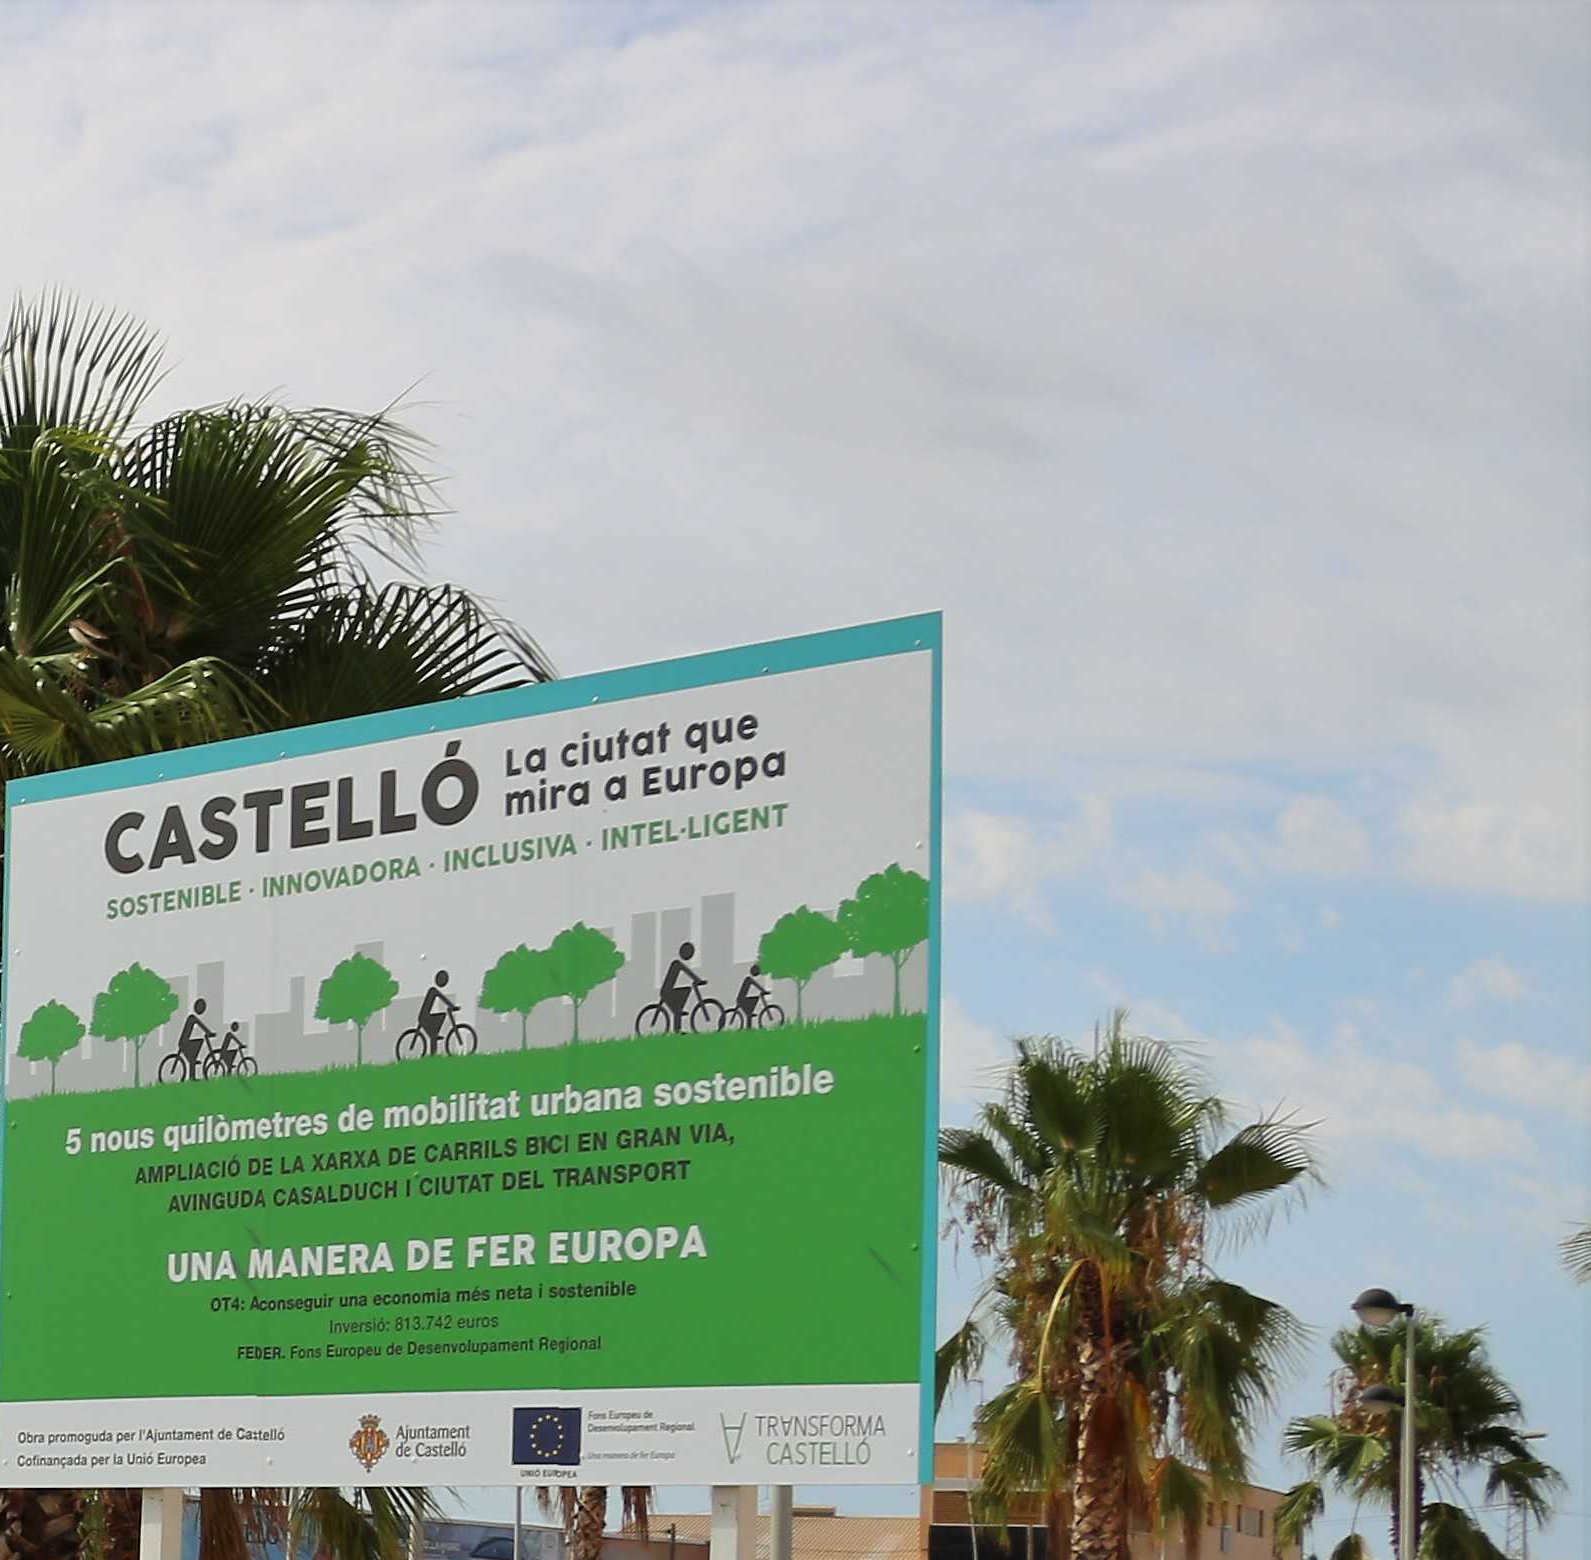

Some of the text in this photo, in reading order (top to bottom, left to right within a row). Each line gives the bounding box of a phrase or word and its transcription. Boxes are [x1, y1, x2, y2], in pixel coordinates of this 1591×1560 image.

[505, 713, 759, 778] La ciutat que
[505, 749, 786, 817] mira a Europa
[104, 739, 480, 874] CASTELLÓ
[106, 880, 242, 920] SOSTENIBLE
[262, 855, 421, 898] INNOVADORA
[443, 832, 578, 873] INCLUSIVA
[65, 1063, 836, 1155] 5 nous quilòmetres de mobilitat urbana sostenible
[135, 1122, 735, 1184] AMPLIACIÓ DE LA XARXA DE CARRILS BICI EN GRAN VIA,
[167, 1160, 691, 1213] AVINGUDA CASALDUCH I CIUTAT DEL TRANSPORT
[167, 1224, 708, 1283] UNA MANERA DE FER EUROPA
[210, 1280, 637, 1312] OT4: Aconseguir una economia més neta i sostenible
[329, 1315, 499, 1334] Inversió: 813.742 euros
[237, 1335, 601, 1360] FEDER. Fons Europeu de Desenvolupament Regional
[18, 1427, 285, 1445] Obra promoguda per l'Ajuntament de Castelló
[395, 1424, 471, 1441] Ajuntament
[395, 1438, 467, 1458] de Castelló
[766, 1437, 871, 1466] CASTELLÓ
[17, 1452, 206, 1469] Cofinançada per la Unió Europea
